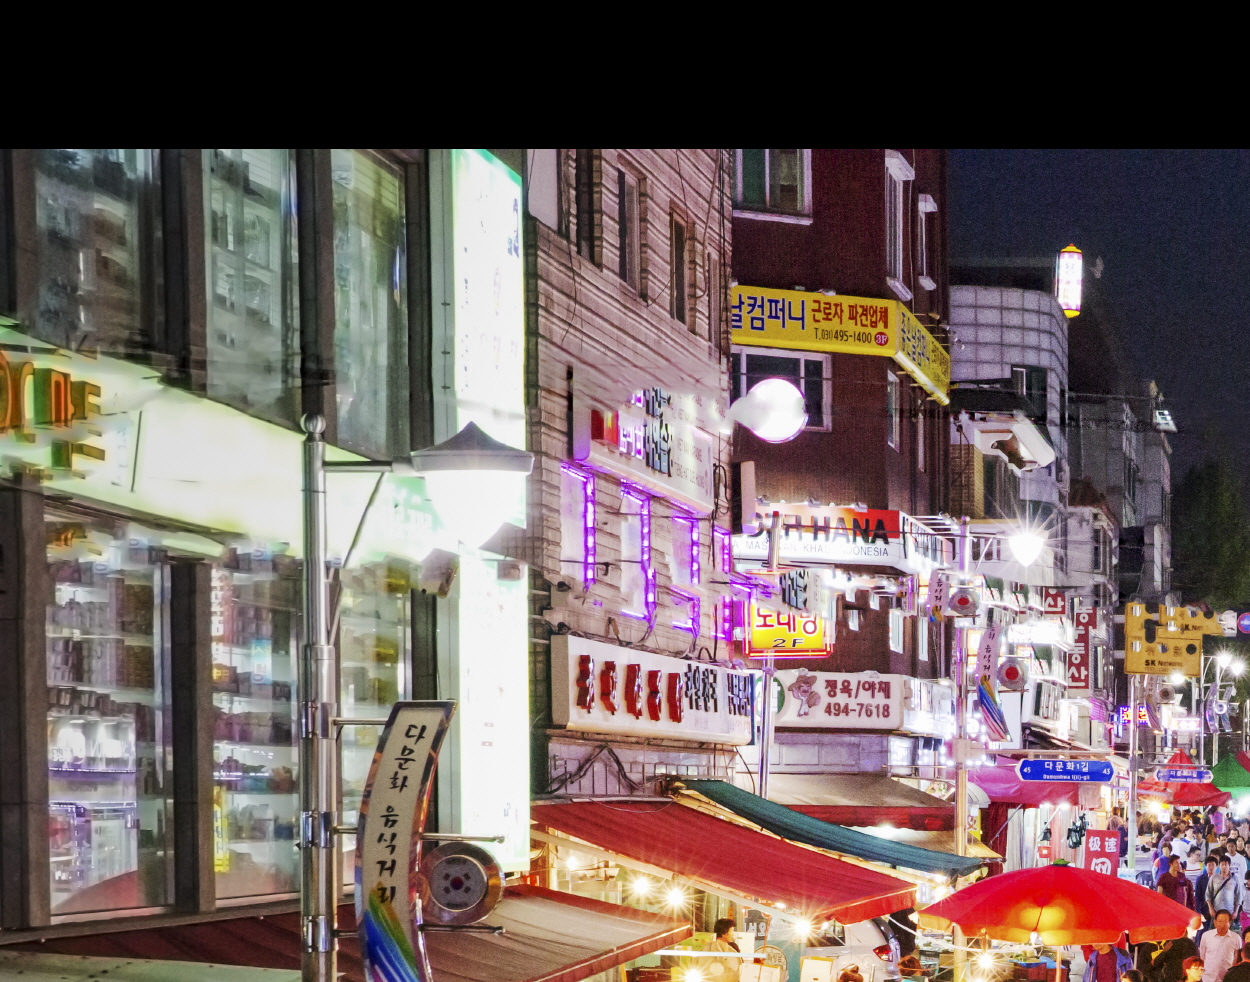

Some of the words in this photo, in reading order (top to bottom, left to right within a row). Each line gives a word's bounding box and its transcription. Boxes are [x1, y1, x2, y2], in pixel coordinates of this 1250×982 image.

[811, 299, 844, 324] 근로자
[847, 304, 889, 329] 파견업체
[874, 331, 889, 346] 3F
[772, 638, 804, 649] 2F
[824, 679, 891, 700] 정육/야채
[824, 702, 891, 719] 494-7618
[388, 723, 428, 794] 다문화
[375, 803, 402, 905] 음식거리
[1088, 836, 1118, 853] 极速
